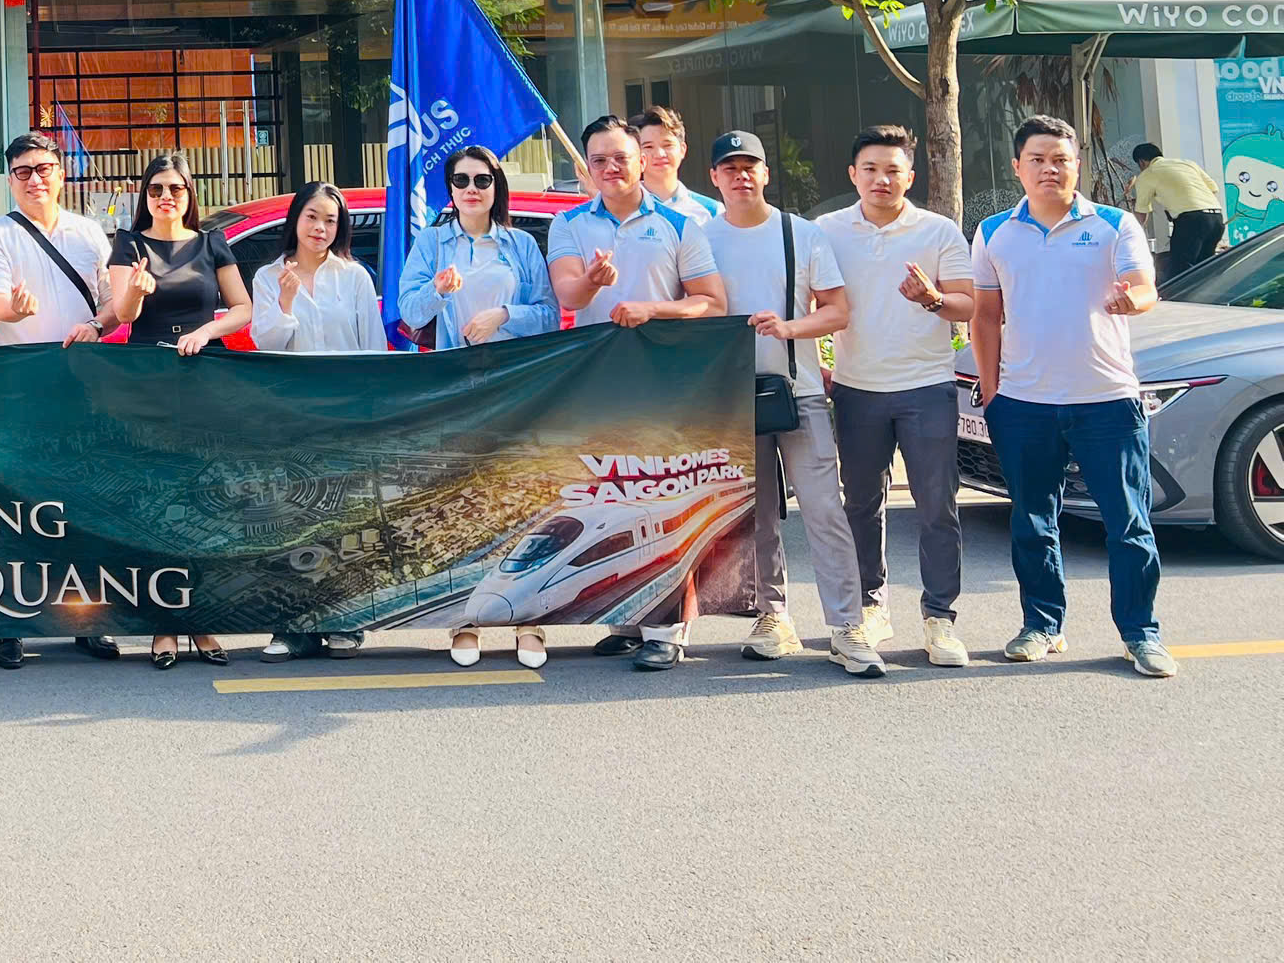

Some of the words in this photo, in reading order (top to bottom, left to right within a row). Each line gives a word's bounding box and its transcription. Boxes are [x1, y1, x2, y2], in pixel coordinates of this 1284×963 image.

[578, 448, 730, 478] VINHOMES
[559, 470, 694, 507] SAIGON
[695, 465, 745, 487] PARK
